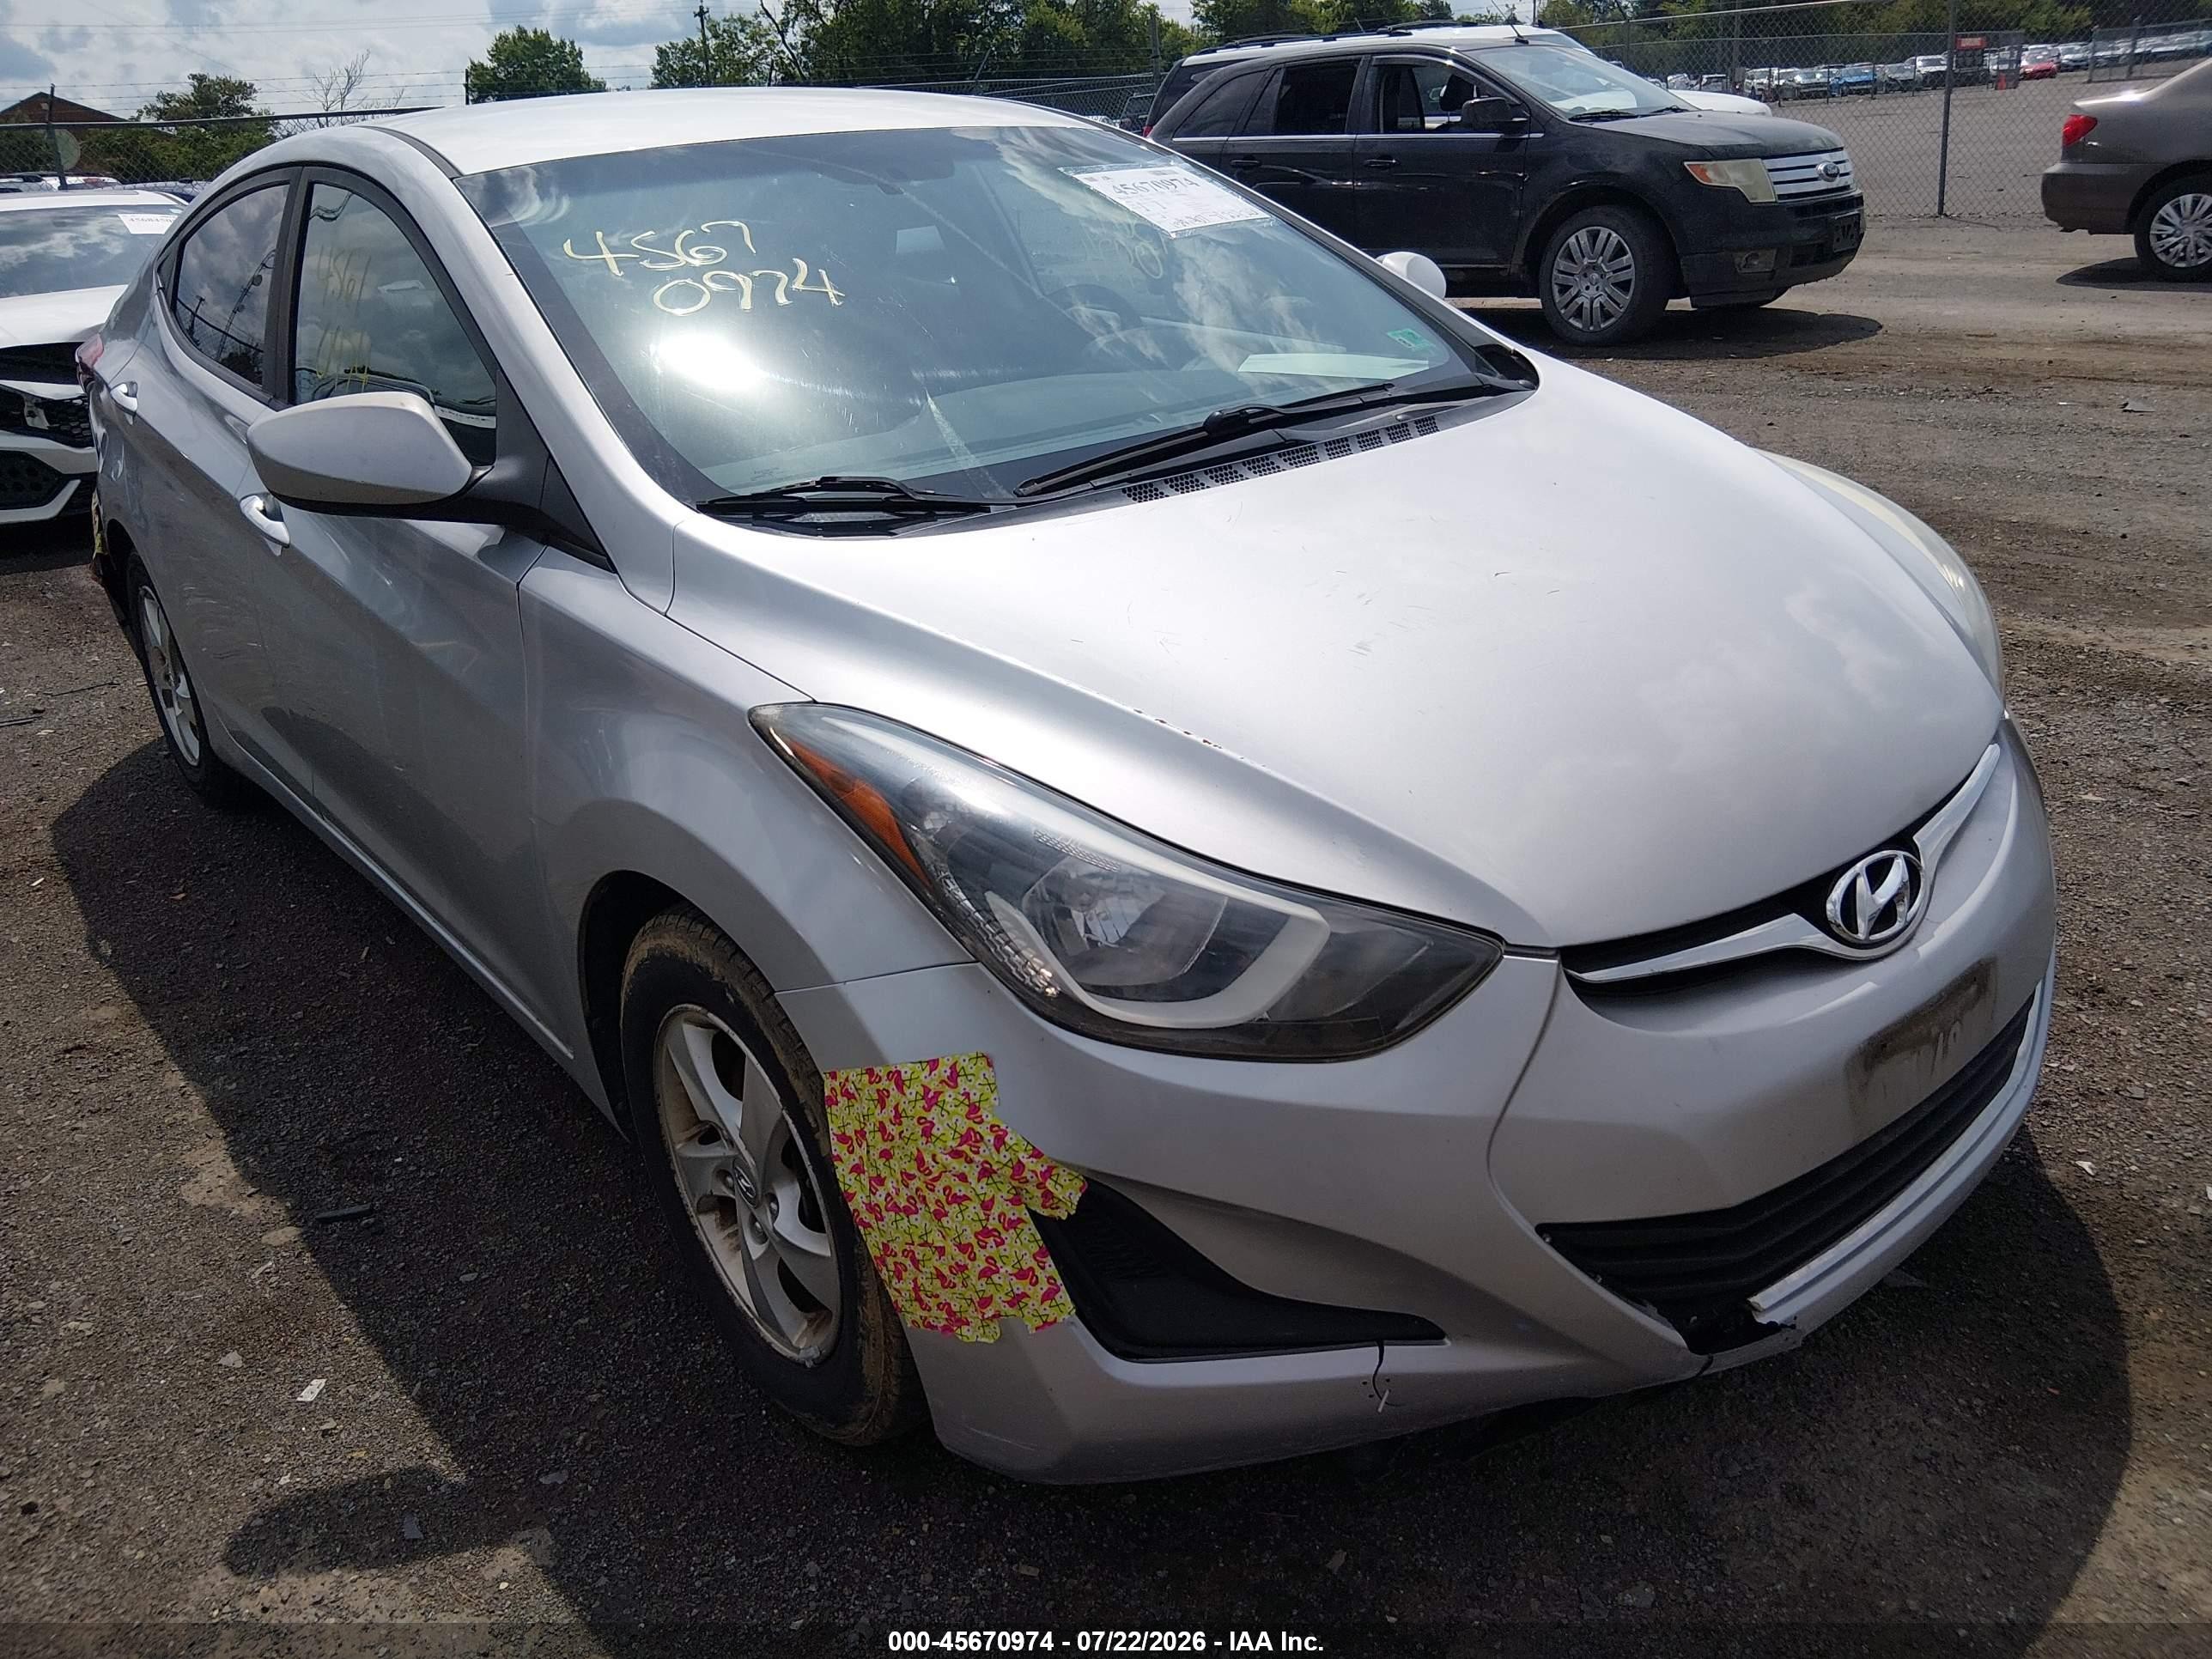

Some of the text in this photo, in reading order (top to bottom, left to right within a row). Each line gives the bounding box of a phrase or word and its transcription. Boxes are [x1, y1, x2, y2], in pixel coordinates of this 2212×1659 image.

[1112, 178, 1200, 197] 45670974
[562, 220, 757, 276] 4567
[653, 258, 846, 316] 0974
